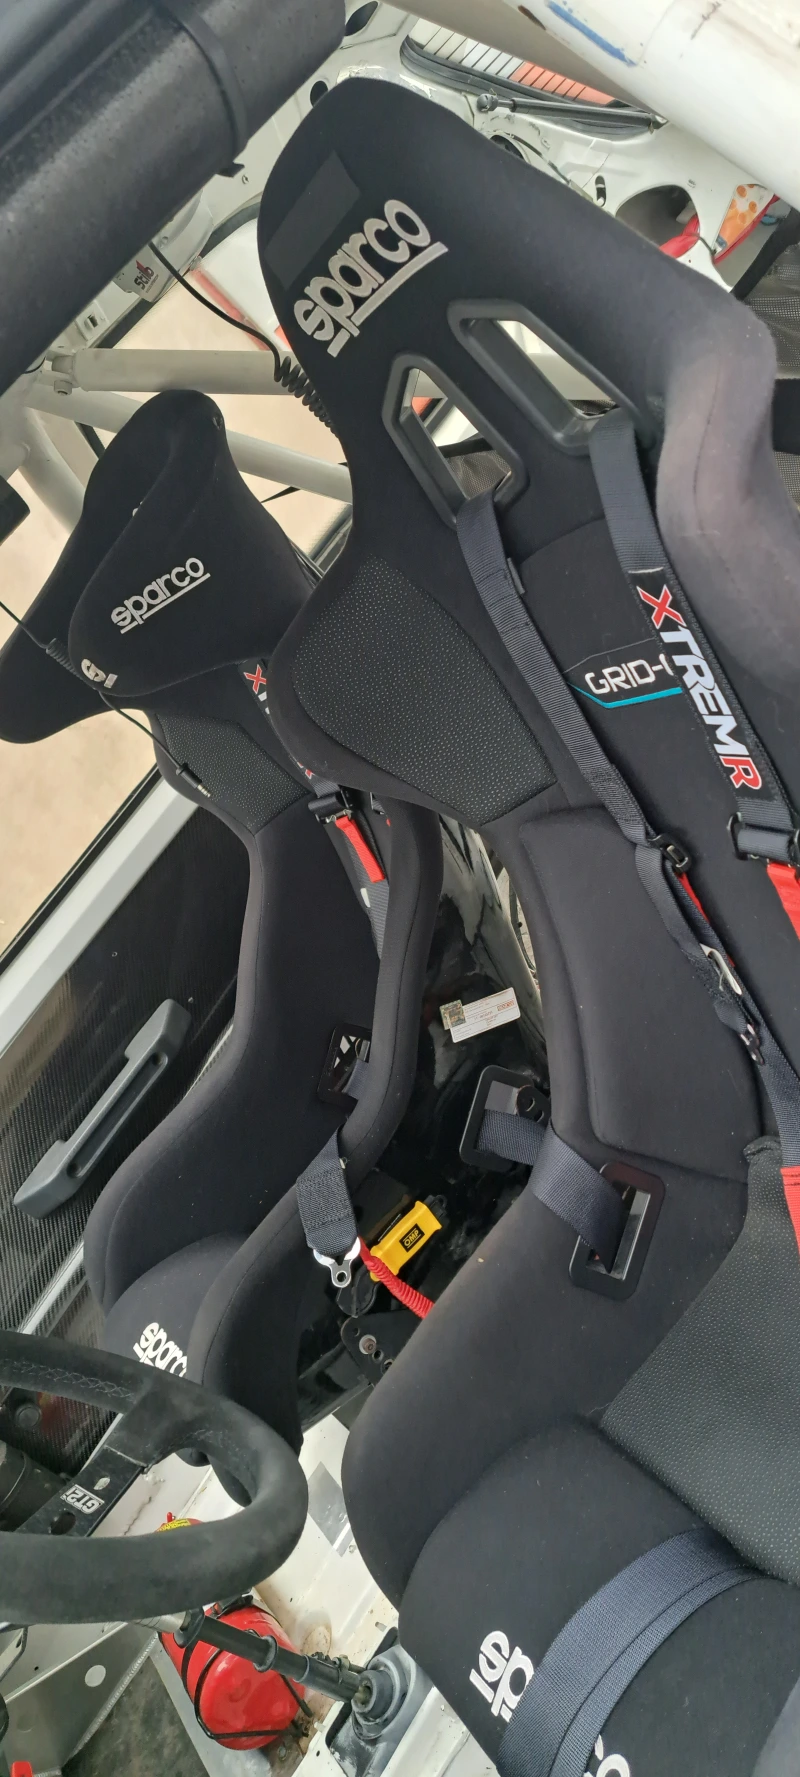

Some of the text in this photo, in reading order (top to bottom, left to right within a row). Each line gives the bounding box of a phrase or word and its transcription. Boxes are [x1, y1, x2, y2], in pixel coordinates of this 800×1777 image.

[294, 199, 431, 342] sparco
[111, 557, 205, 626] sparco
[585, 653, 674, 695] GRID-
[636, 584, 762, 790] XTREMR
[404, 1229, 419, 1247] OMP
[139, 1322, 188, 1378] sparc
